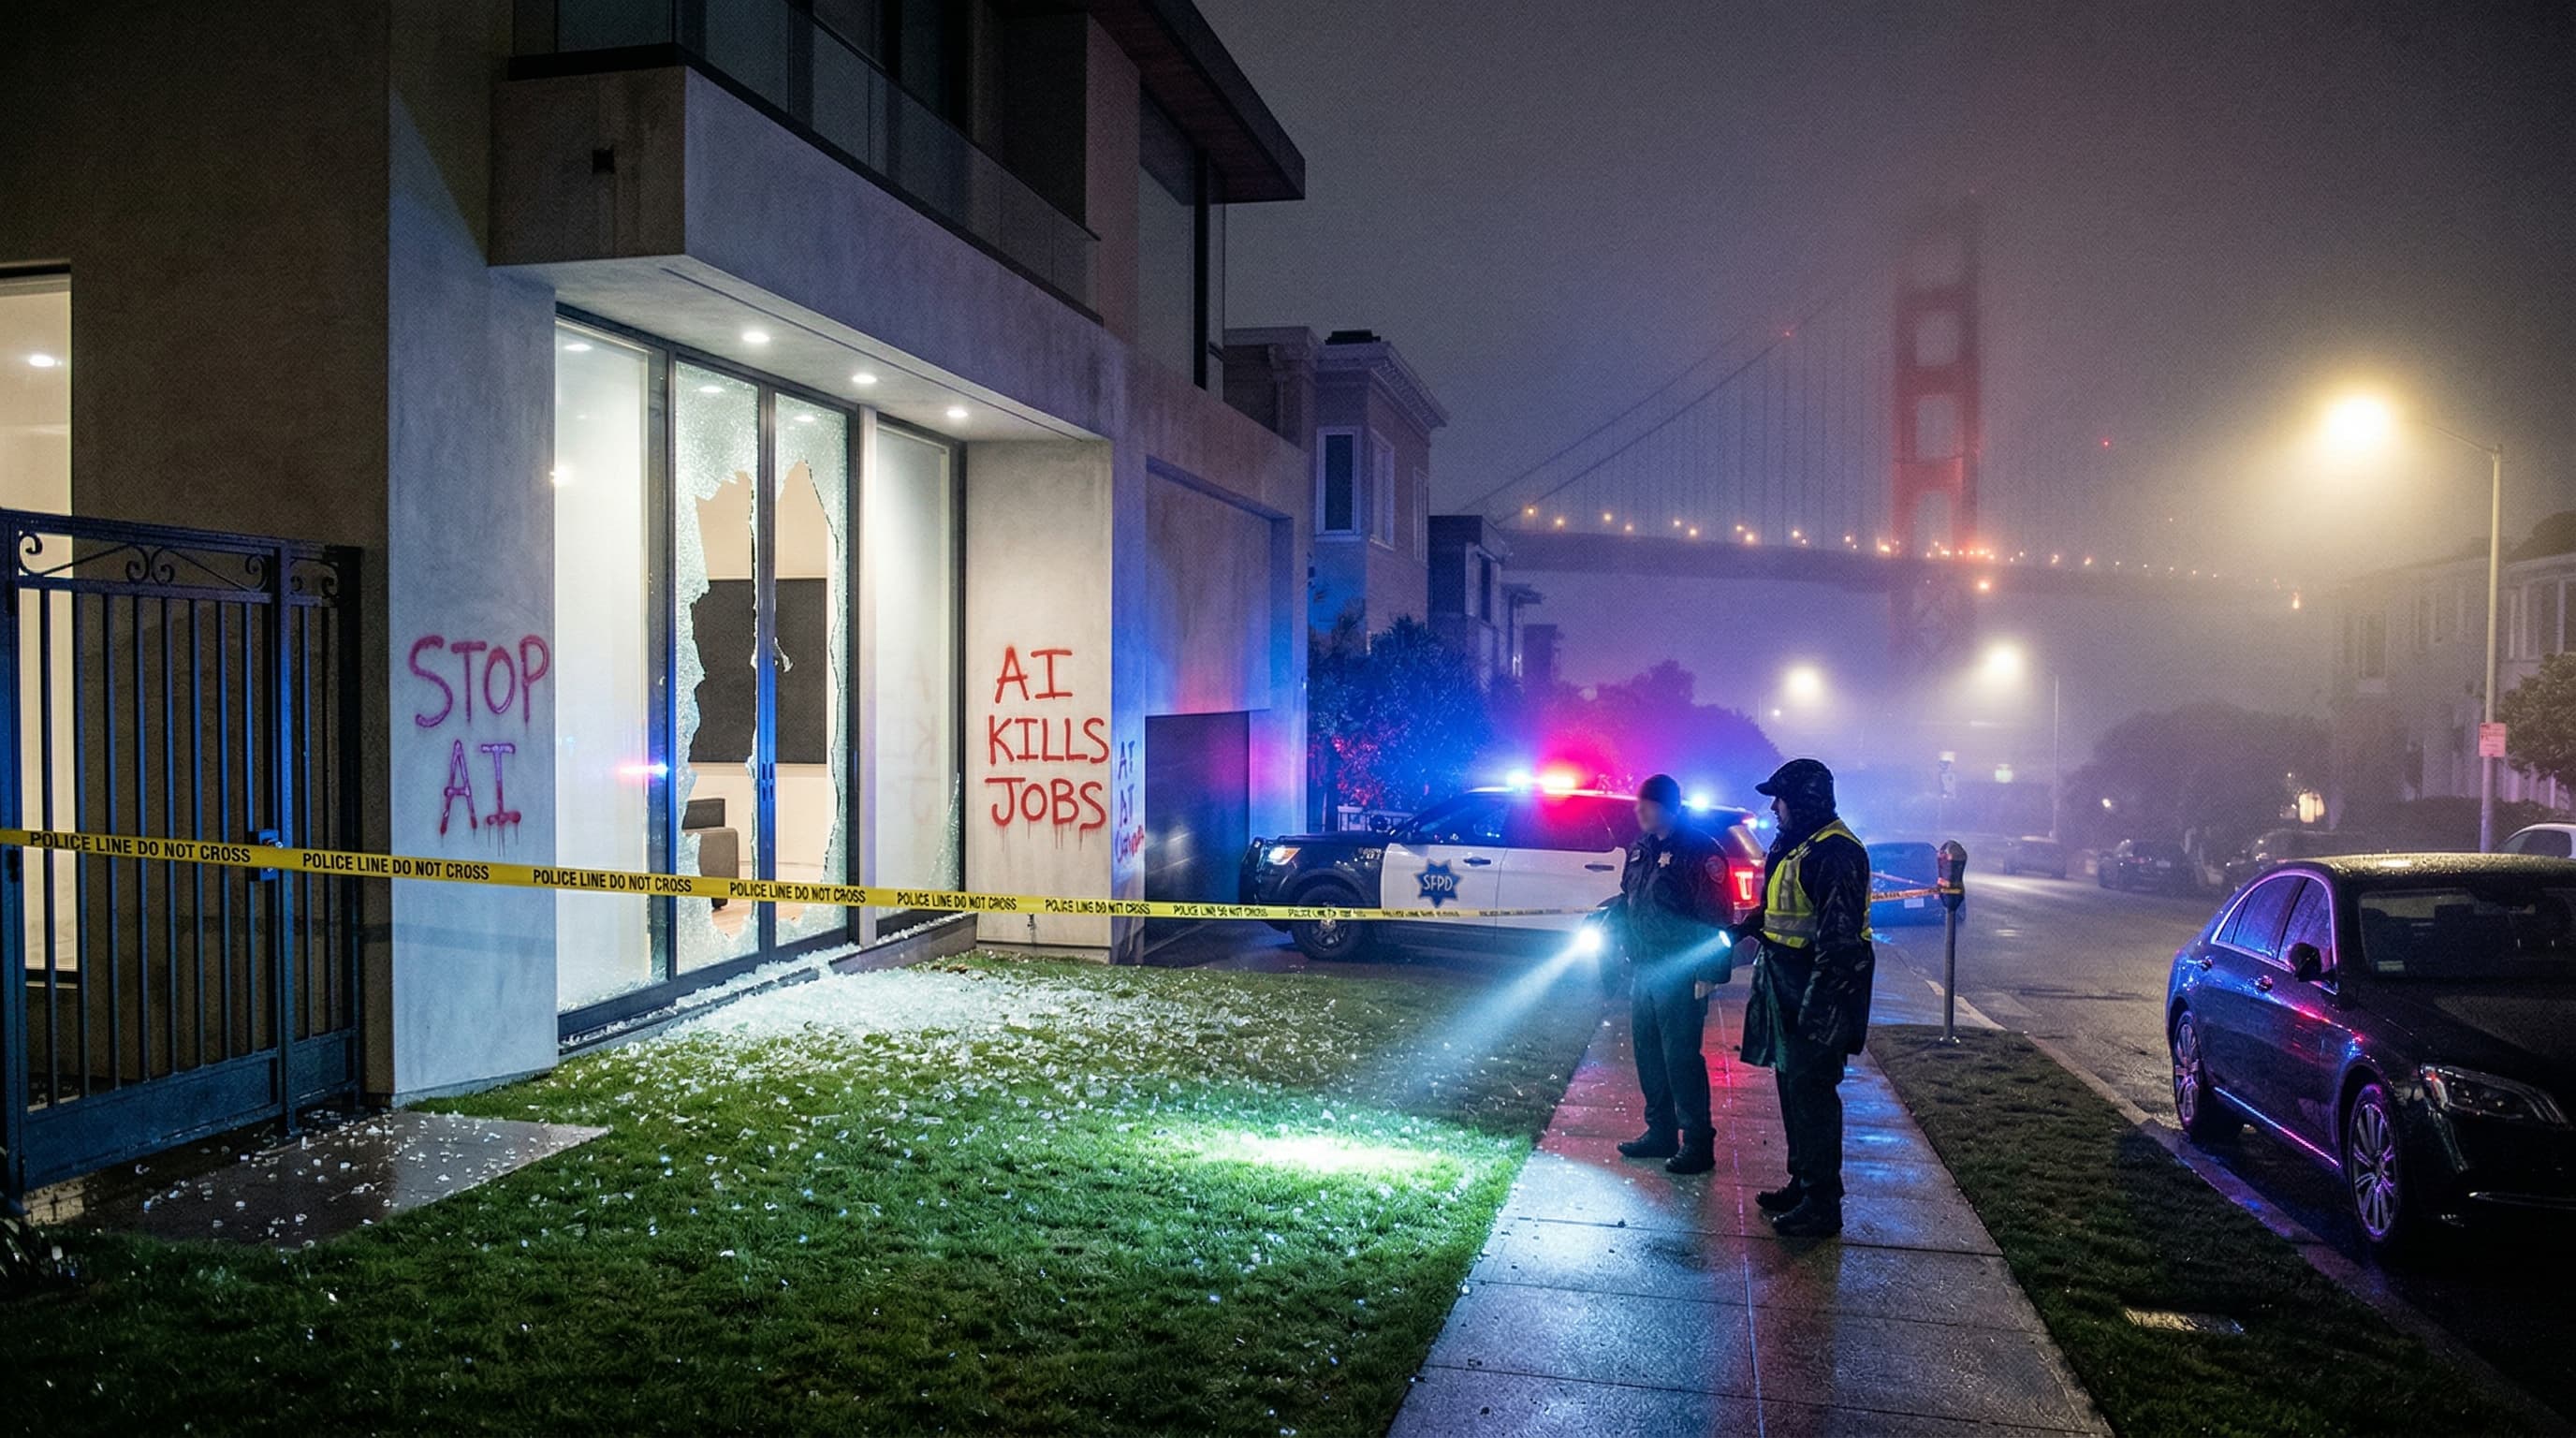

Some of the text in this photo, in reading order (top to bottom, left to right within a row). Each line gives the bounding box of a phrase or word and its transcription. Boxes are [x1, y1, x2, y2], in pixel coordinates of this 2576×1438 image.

[409, 634, 550, 727] STOP
[994, 646, 1073, 704] AI
[988, 714, 1109, 765] KILLS
[440, 739, 521, 836] AI
[984, 777, 1107, 832] JOBS
[30, 831, 251, 862] POLICE LINE DO NOT CROSS
[302, 853, 489, 880] POLICE LINE DO NOT CROSS
[534, 869, 692, 892] POLICE LINE DO NOT CROSS
[730, 882, 767, 897] POLICE
[769, 885, 792, 899] LINE
[795, 886, 809, 900] DO
[812, 888, 830, 901] NOT
[1424, 874, 1453, 891] SFPD
[954, 895, 967, 907] DO
